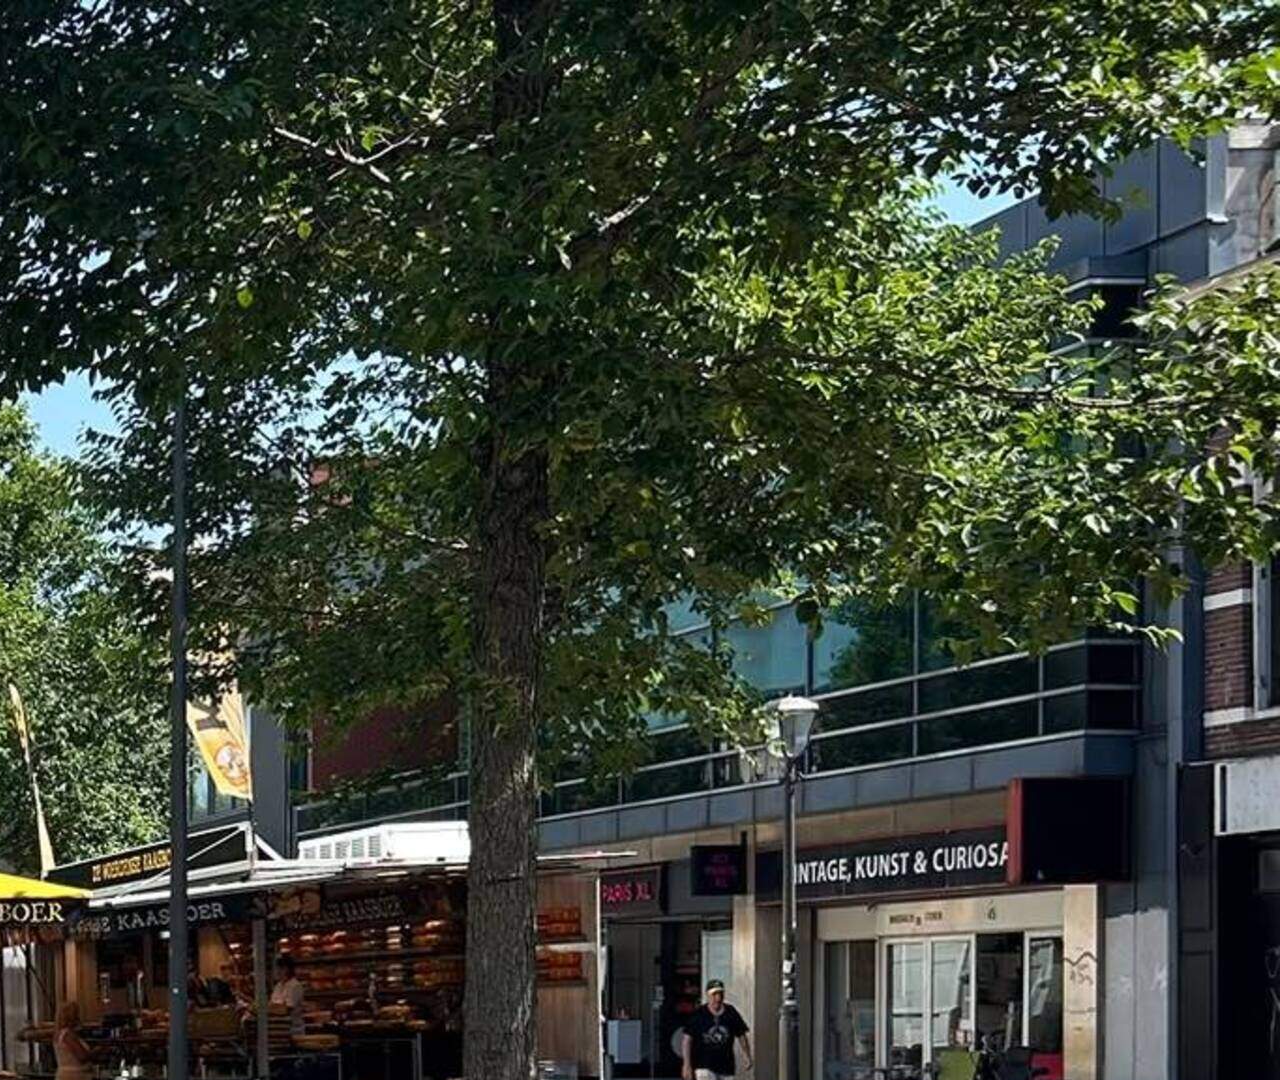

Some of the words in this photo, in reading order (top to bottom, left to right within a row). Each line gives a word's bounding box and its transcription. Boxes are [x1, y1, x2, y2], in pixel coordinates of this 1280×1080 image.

[855, 852, 910, 879] KUNST
[913, 850, 928, 874] &
[117, 902, 226, 932] KAASOER
